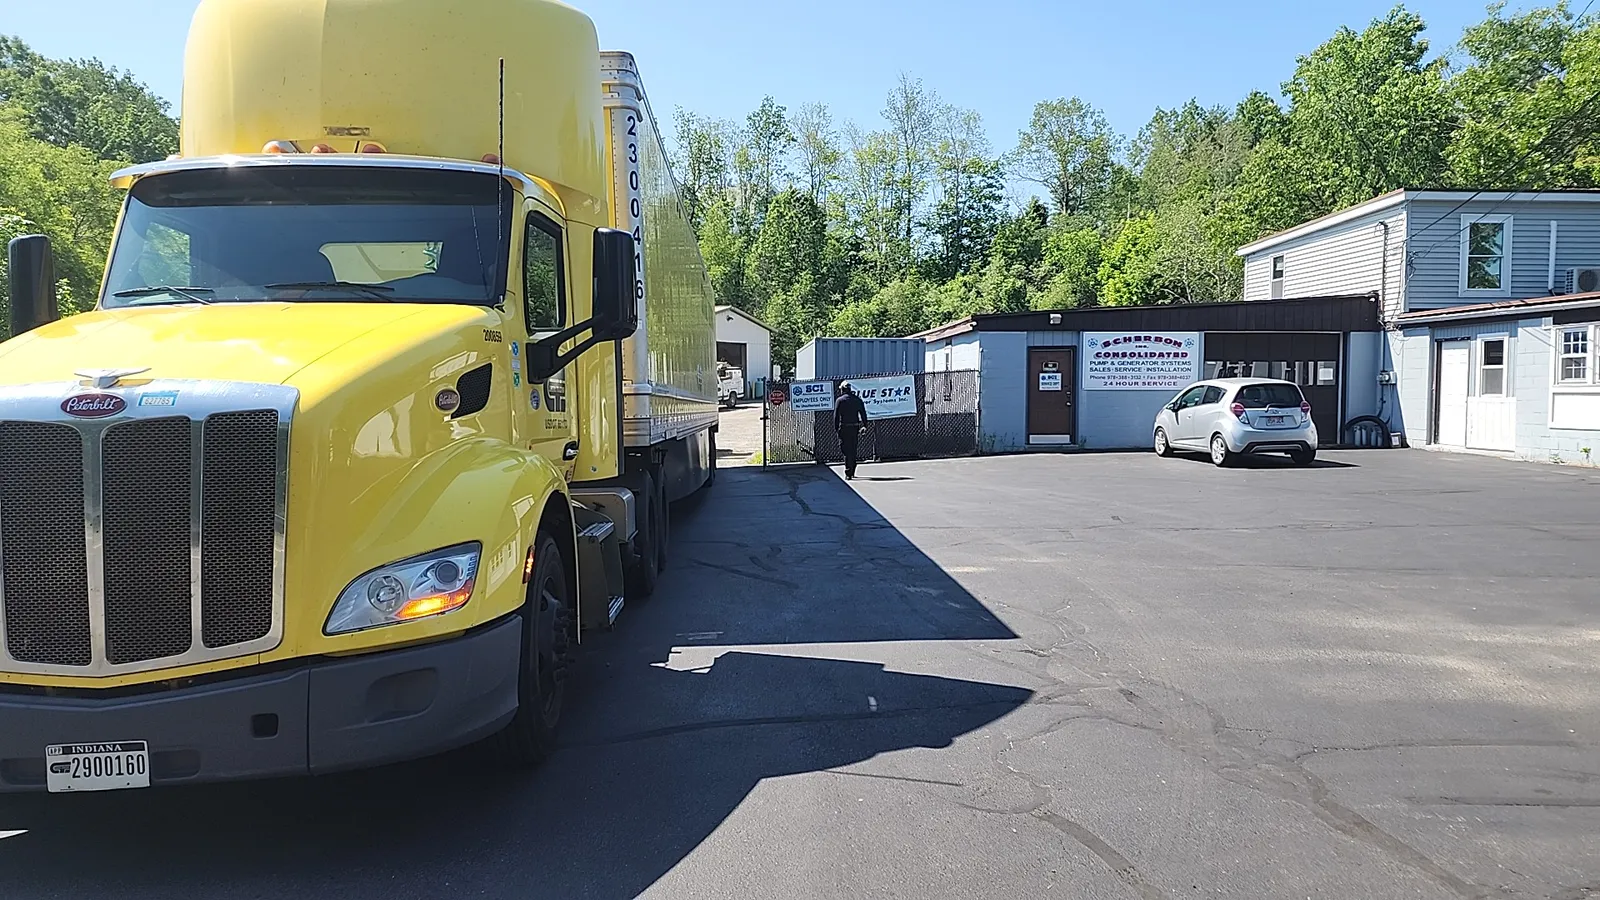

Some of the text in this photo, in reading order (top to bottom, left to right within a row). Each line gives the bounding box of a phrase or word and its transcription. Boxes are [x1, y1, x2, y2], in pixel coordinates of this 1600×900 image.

[626, 115, 644, 300] 2300416
[1101, 335, 1183, 348] SCHERBON
[66, 397, 120, 412] Peterbilt
[72, 744, 122, 753] INDIANA
[72, 754, 145, 778] 2900160
